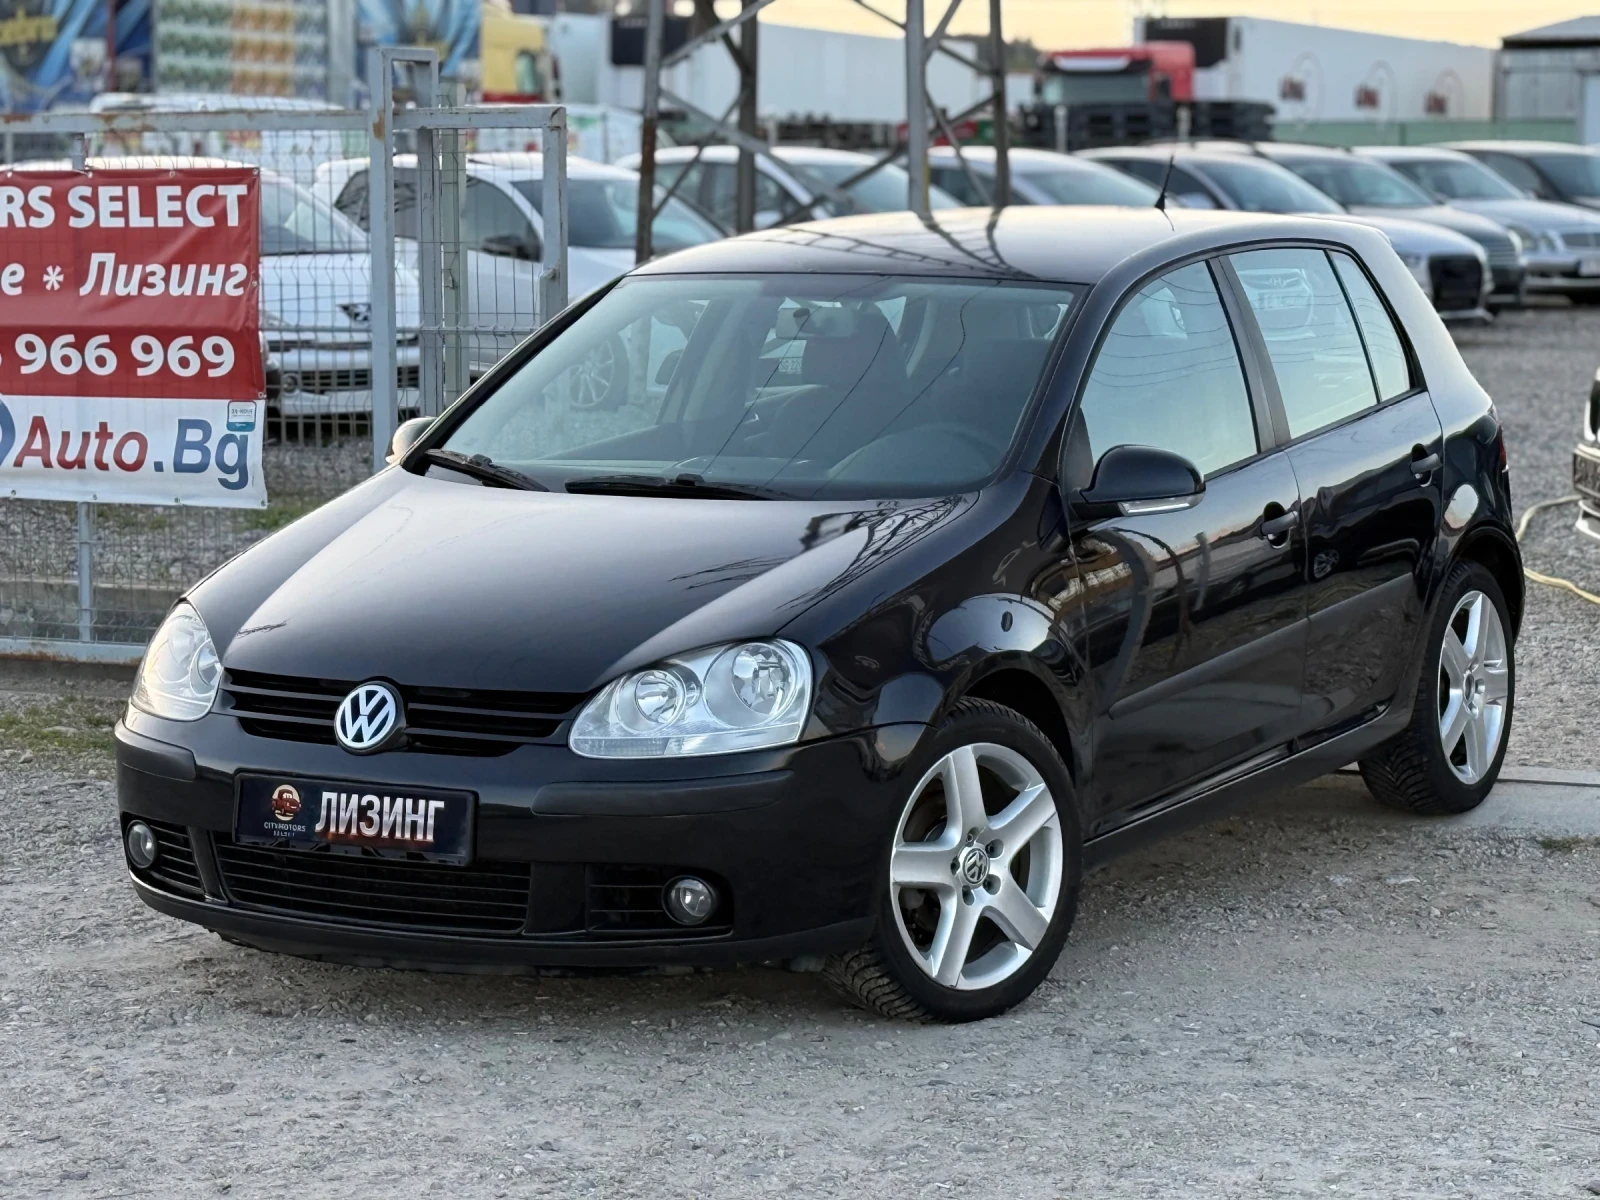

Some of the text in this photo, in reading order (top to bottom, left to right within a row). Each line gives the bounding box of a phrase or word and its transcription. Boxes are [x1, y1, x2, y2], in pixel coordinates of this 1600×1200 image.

[68, 184, 248, 228] SELECT
[79, 252, 248, 296] Лизинг
[14, 333, 236, 378] 966 969
[315, 791, 445, 843] ЛИЗИНГ
